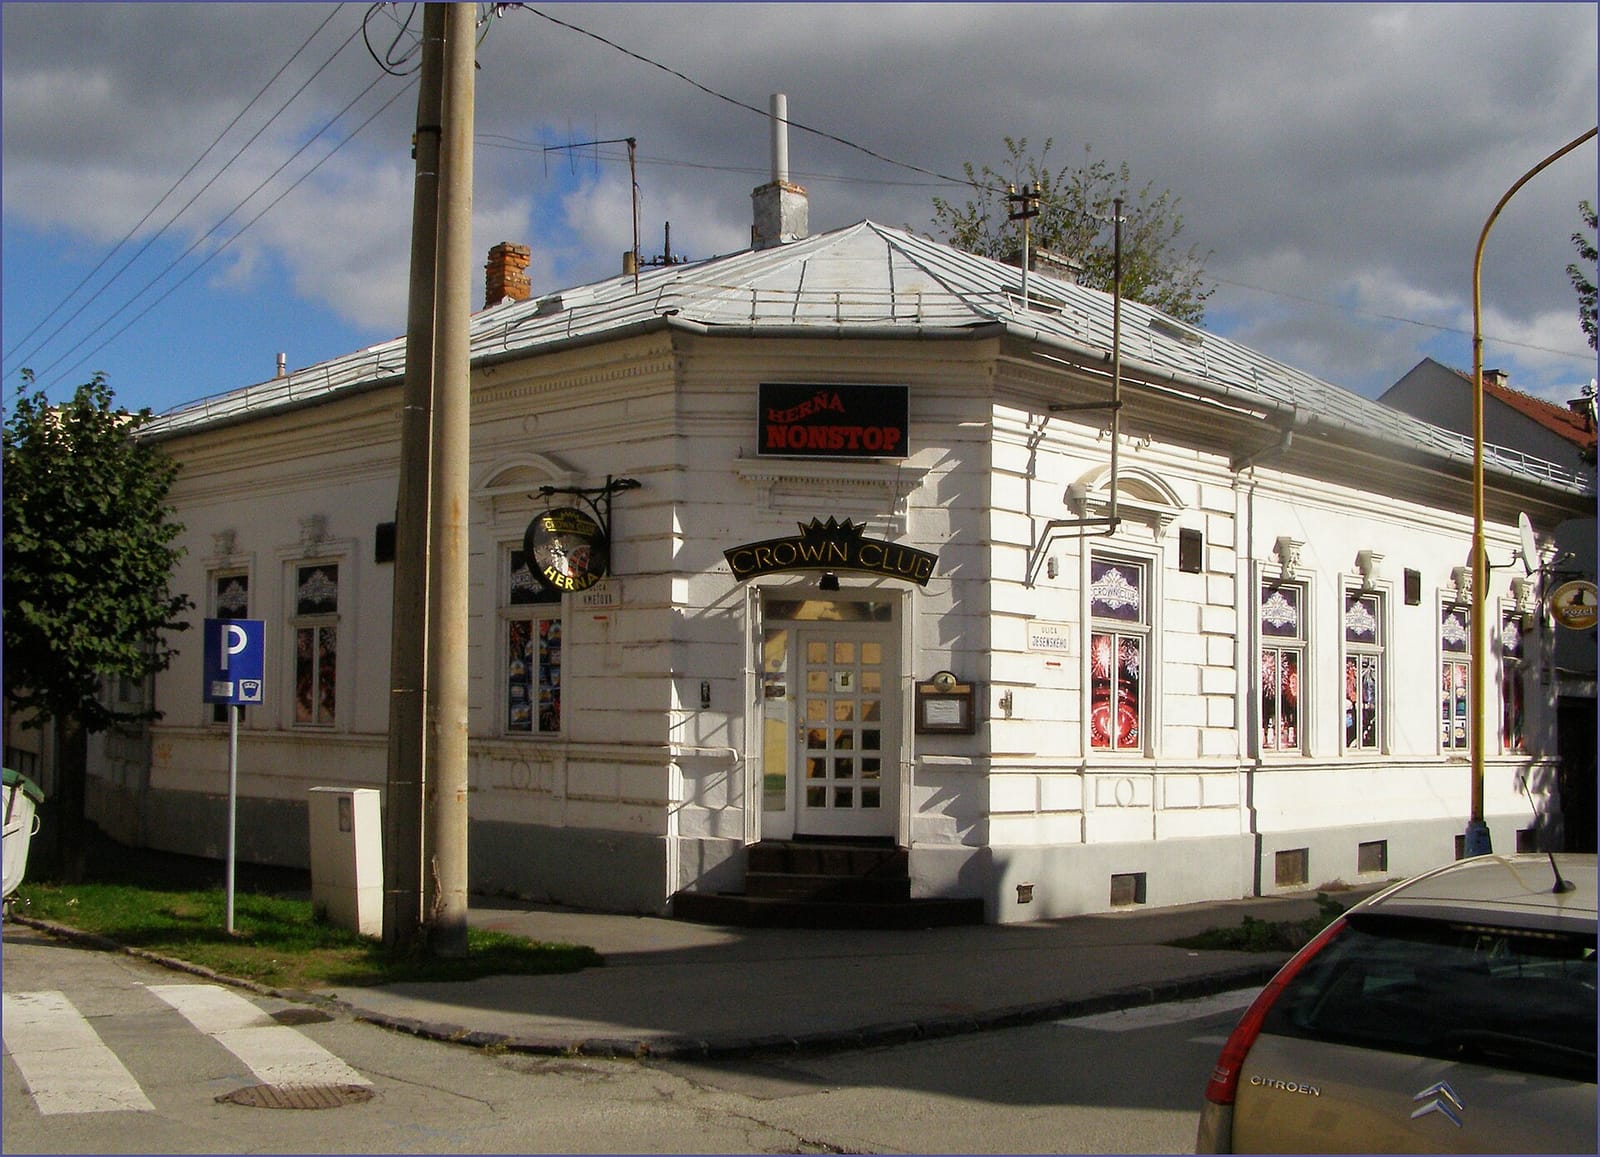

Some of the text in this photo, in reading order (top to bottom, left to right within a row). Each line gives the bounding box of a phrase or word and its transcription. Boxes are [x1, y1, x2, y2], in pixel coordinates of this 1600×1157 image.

[766, 425, 901, 450] NONSTOP
[731, 541, 932, 579] CROWN CLUB
[1093, 587, 1135, 601] CROWN CLUB
[221, 624, 248, 671] P
